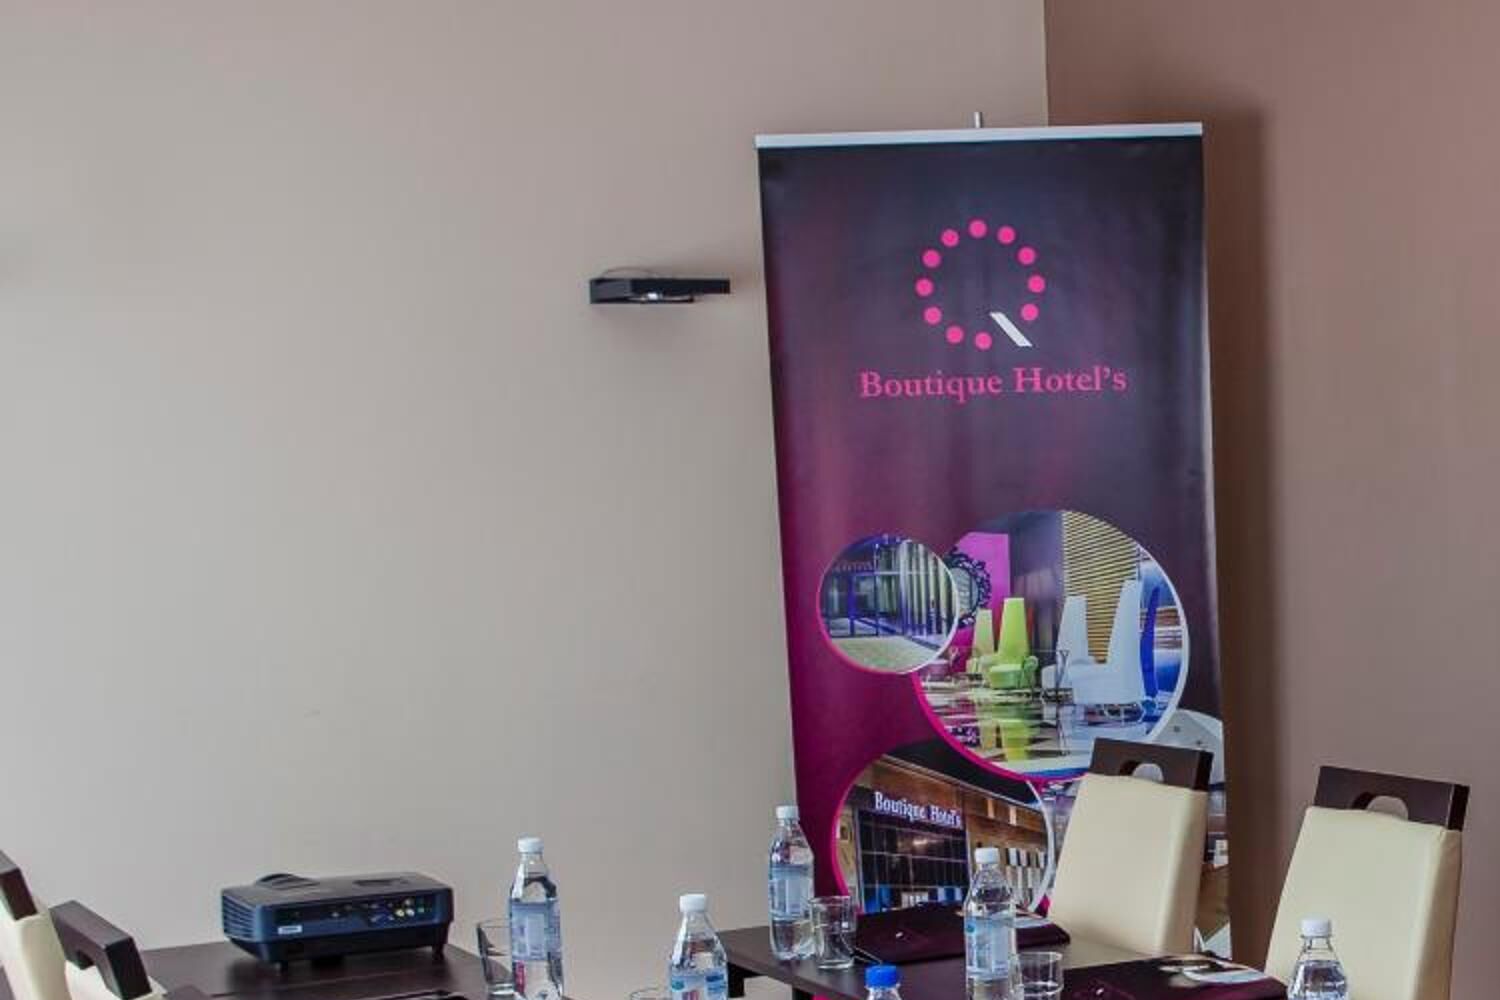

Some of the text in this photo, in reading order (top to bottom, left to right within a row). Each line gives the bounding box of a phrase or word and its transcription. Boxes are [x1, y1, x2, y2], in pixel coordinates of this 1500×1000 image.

[859, 365, 1128, 404] Boutique Hotel's
[874, 790, 926, 823] Boutique
